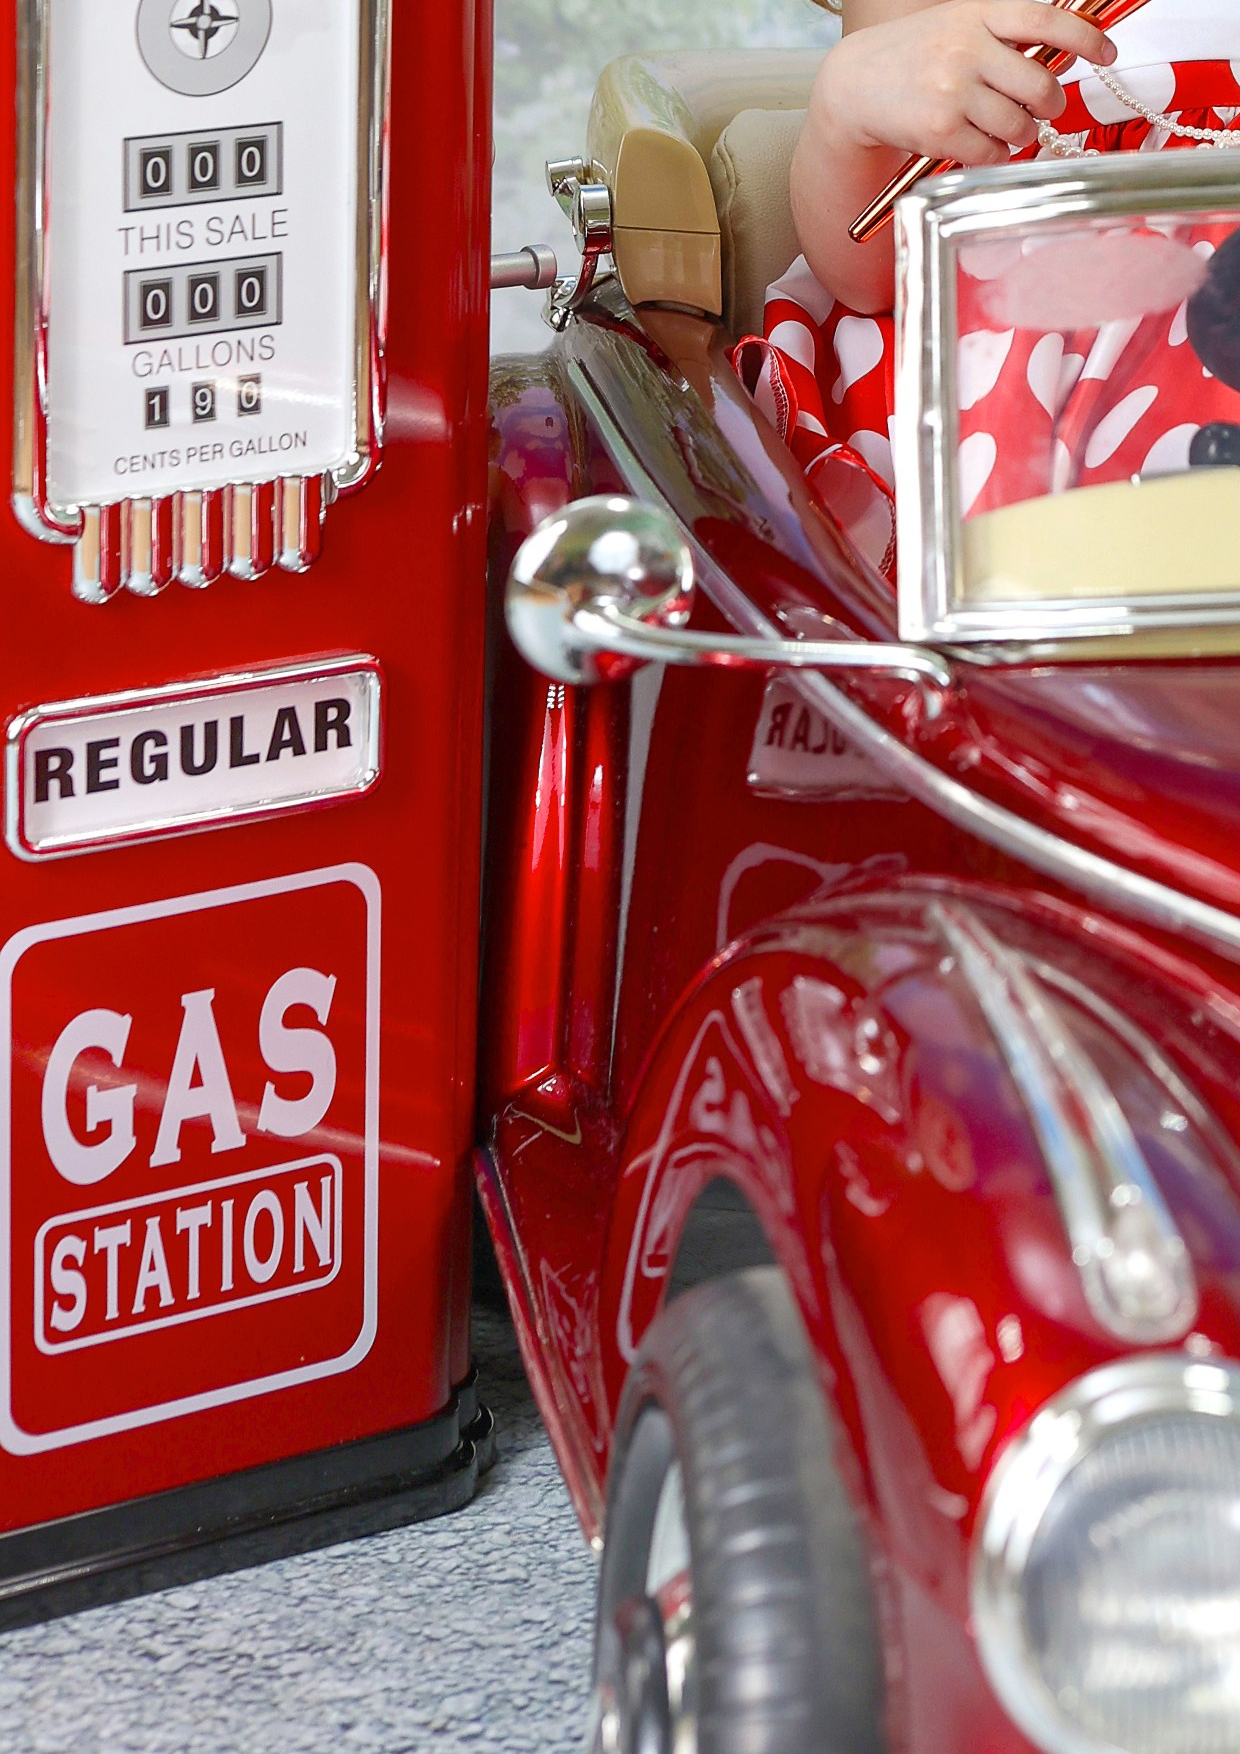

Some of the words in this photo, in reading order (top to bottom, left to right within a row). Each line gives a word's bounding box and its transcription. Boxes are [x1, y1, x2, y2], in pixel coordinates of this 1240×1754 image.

[117, 219, 196, 256] THIS
[205, 208, 289, 247] SALE
[131, 333, 276, 379] GALLONS
[113, 449, 182, 476] CENTS
[185, 442, 225, 464] PER
[228, 430, 308, 459] GALLON
[33, 696, 354, 804] REGULAR
[40, 966, 339, 1187] GAS
[49, 1175, 334, 1334] STATION
